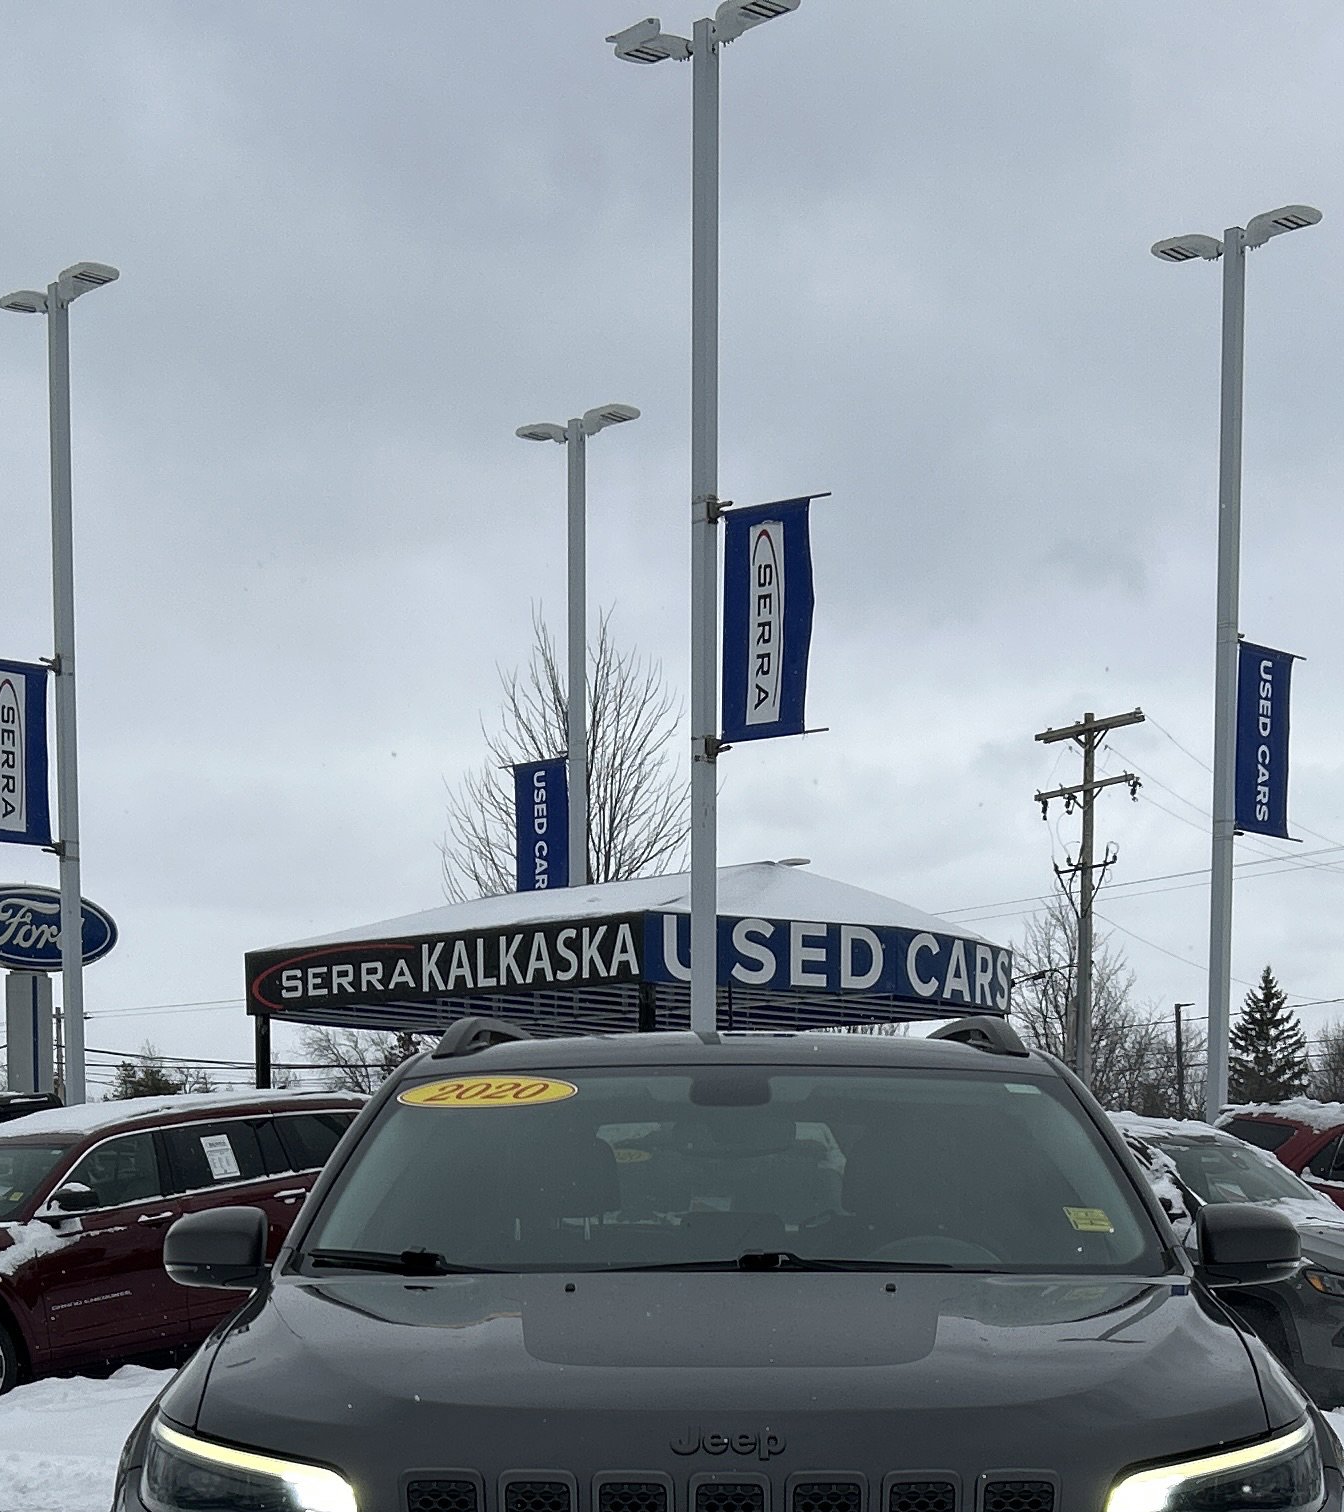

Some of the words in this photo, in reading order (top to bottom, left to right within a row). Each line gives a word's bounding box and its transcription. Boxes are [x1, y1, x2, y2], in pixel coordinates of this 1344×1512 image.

[754, 563, 773, 711] SERRA
[1258, 660, 1273, 737] USED
[1, 704, 16, 819] SERRA
[1256, 744, 1270, 823] CARS
[533, 770, 548, 835] USED
[281, 958, 416, 998] SERRA
[421, 923, 640, 992] KALKASKA
[663, 914, 884, 990] USED
[905, 932, 1008, 1011] CARS
[423, 1082, 550, 1103] 2020
[668, 1423, 787, 1462] Jeep
